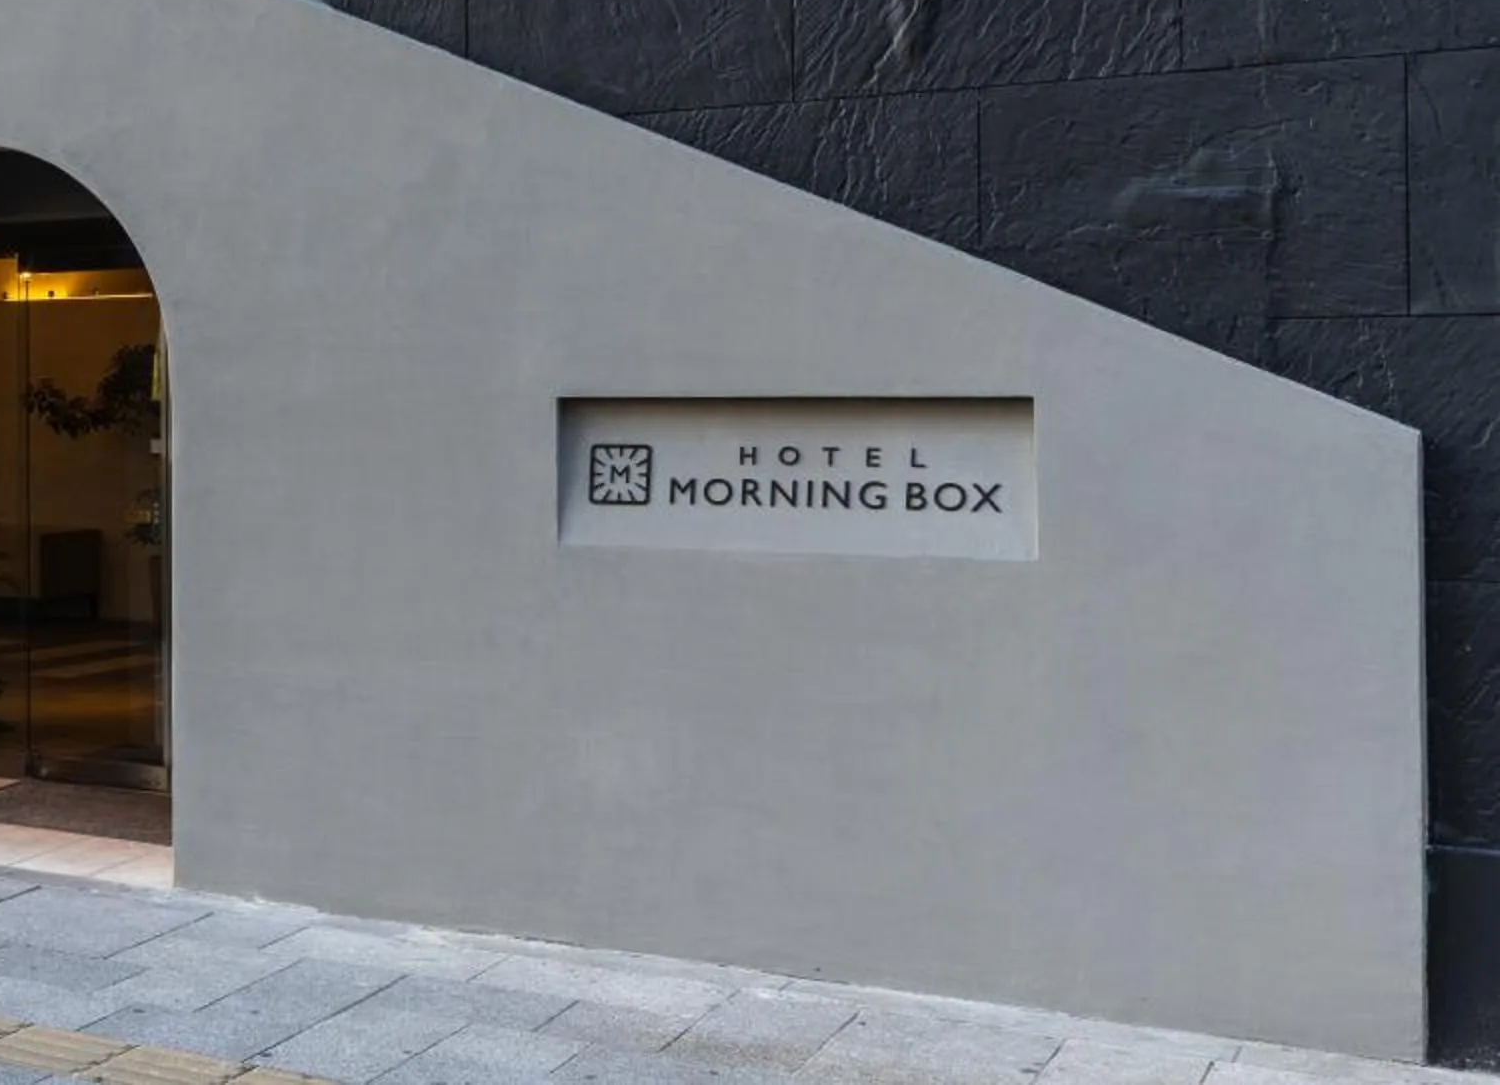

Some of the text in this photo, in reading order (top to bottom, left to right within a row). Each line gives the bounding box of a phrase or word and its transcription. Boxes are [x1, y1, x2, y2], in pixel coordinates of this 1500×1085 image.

[739, 445, 927, 469] HOTEL
[609, 464, 631, 484] M
[669, 477, 1003, 514] MORNING BOX
